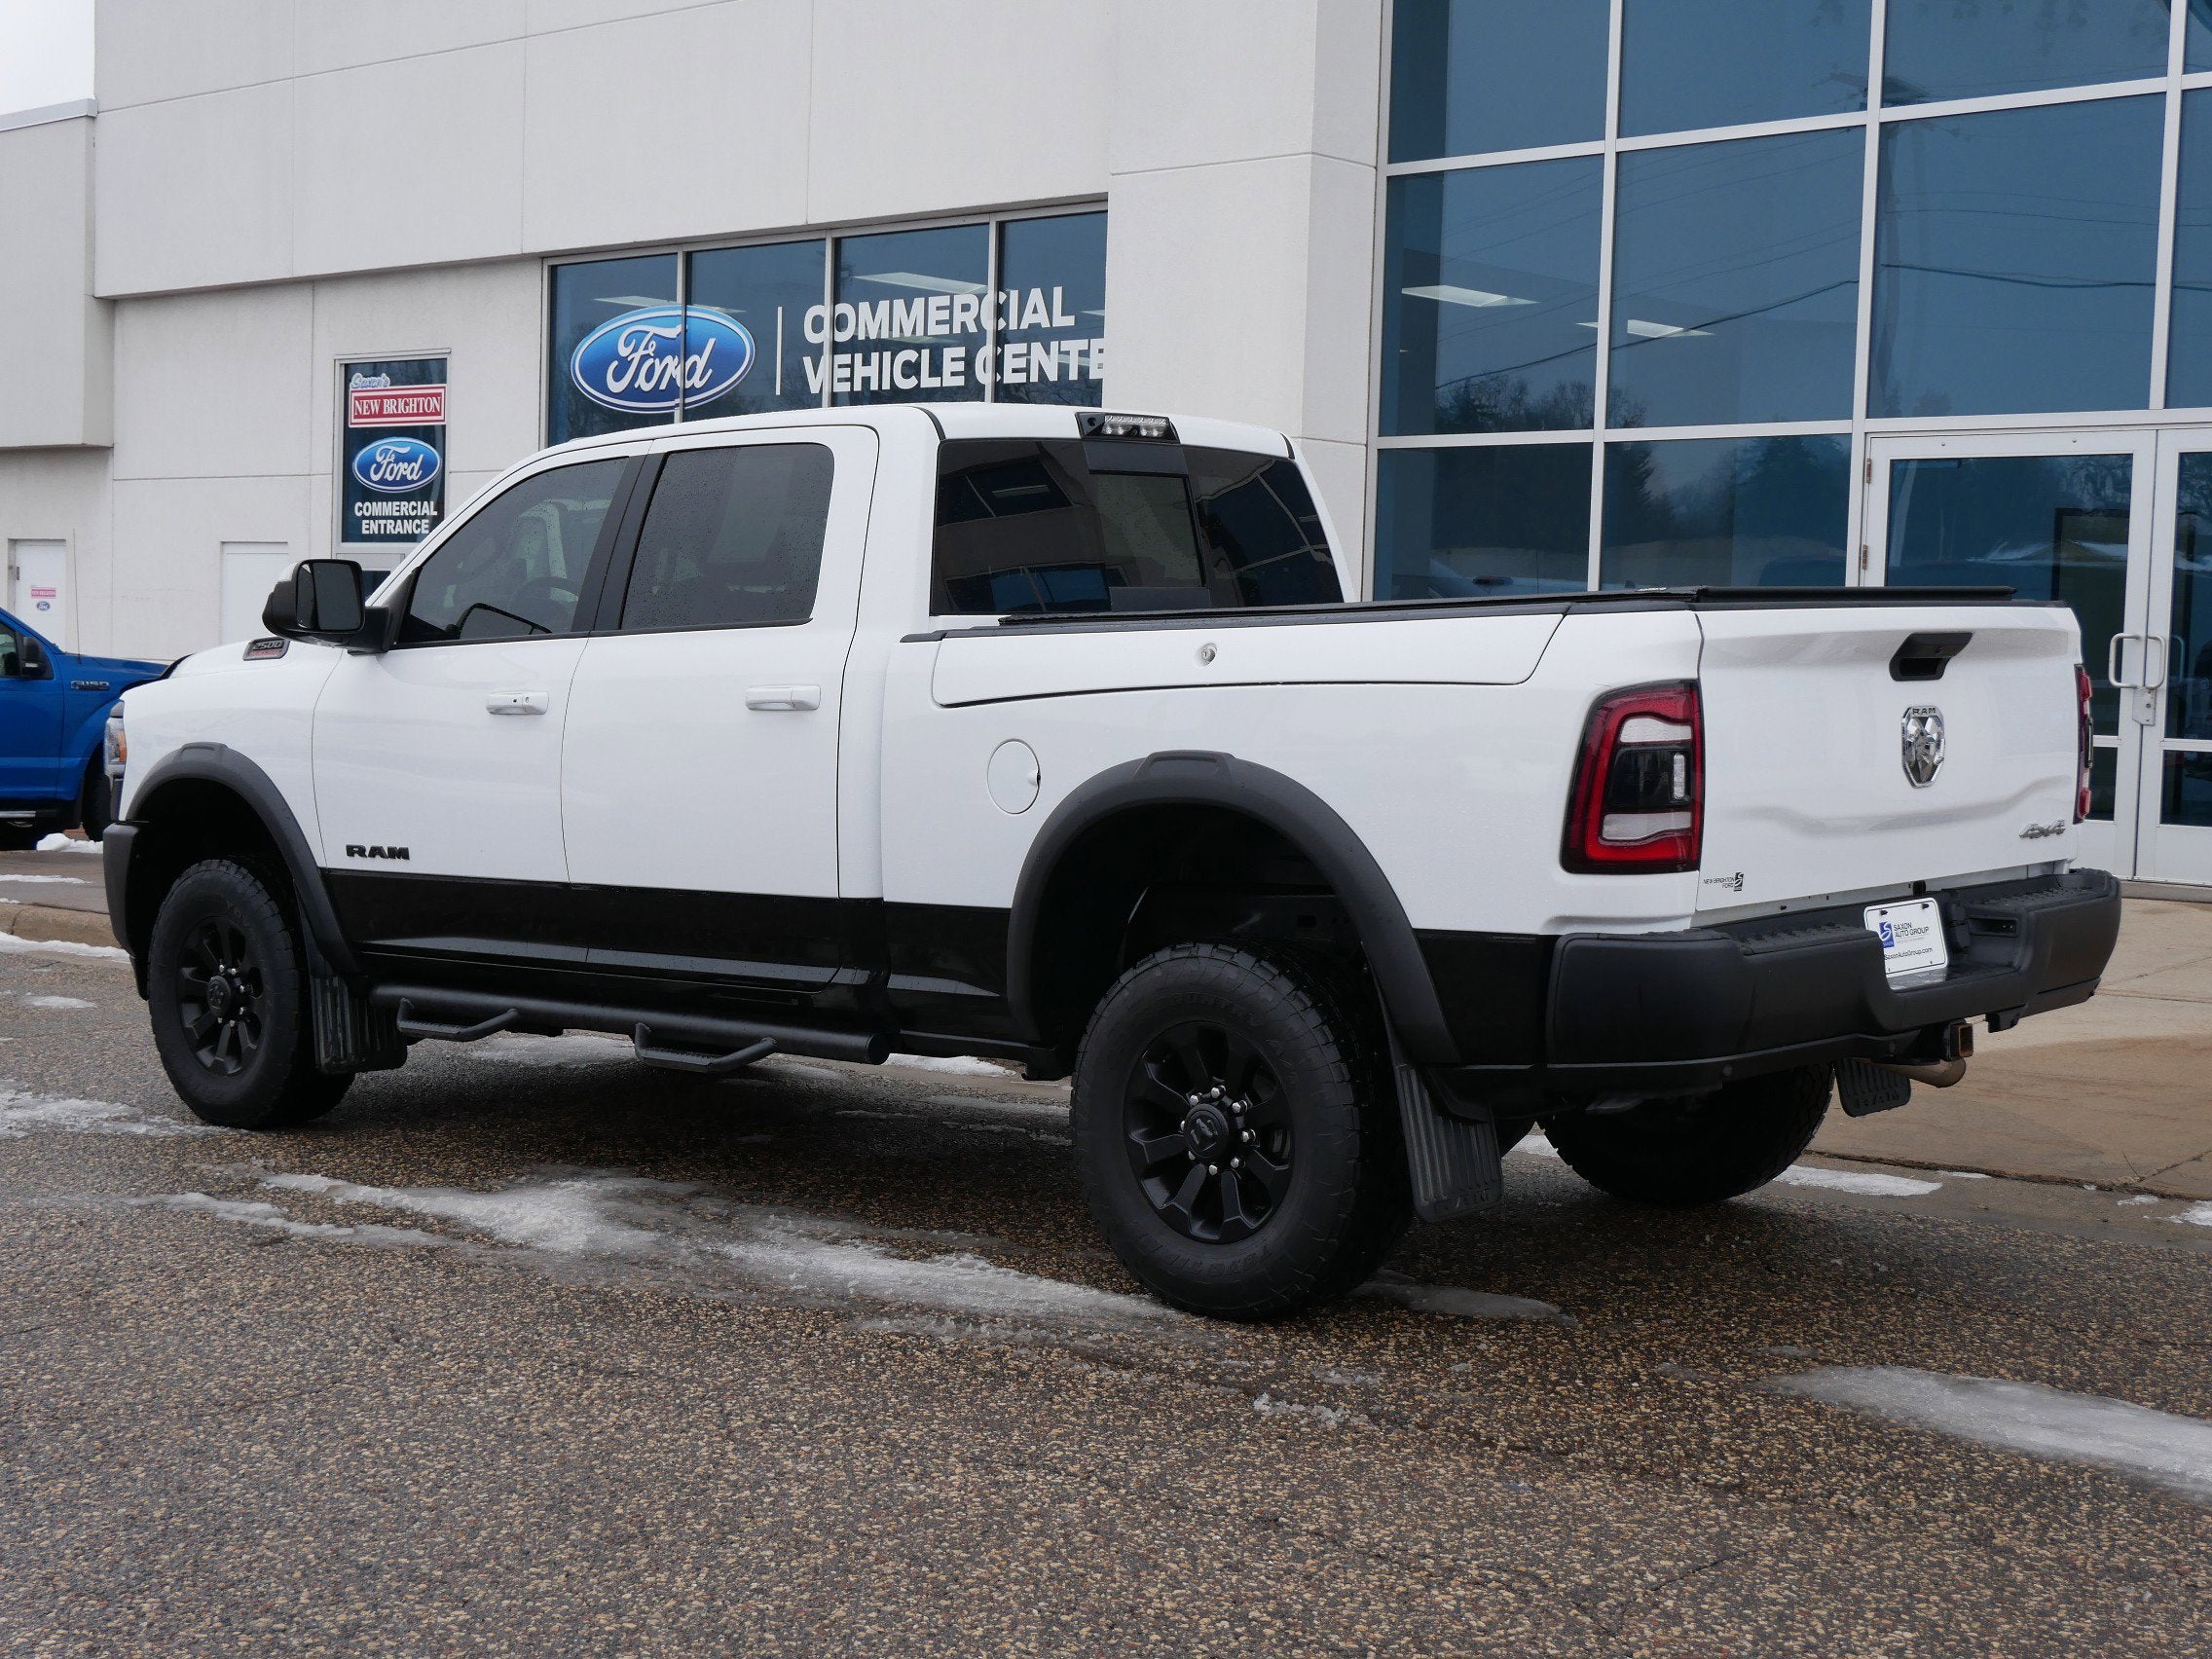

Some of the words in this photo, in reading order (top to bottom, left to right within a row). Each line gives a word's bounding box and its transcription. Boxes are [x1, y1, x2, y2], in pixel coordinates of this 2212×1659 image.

[803, 285, 1075, 345] COMMERCIAL
[606, 324, 717, 394] Ford
[803, 346, 966, 394] VEHICLE
[354, 399, 382, 416] NEW
[383, 395, 441, 415] BRIGHTON
[370, 445, 424, 481] Ford
[354, 500, 438, 517] COMMERCIAL
[361, 519, 429, 535] ENTRANCE
[254, 641, 281, 649] 2500
[1912, 707, 1936, 716] RAM
[346, 843, 410, 860] RAM
[1894, 922, 1912, 932] SAXON
[1909, 926, 1930, 935] GROUP
